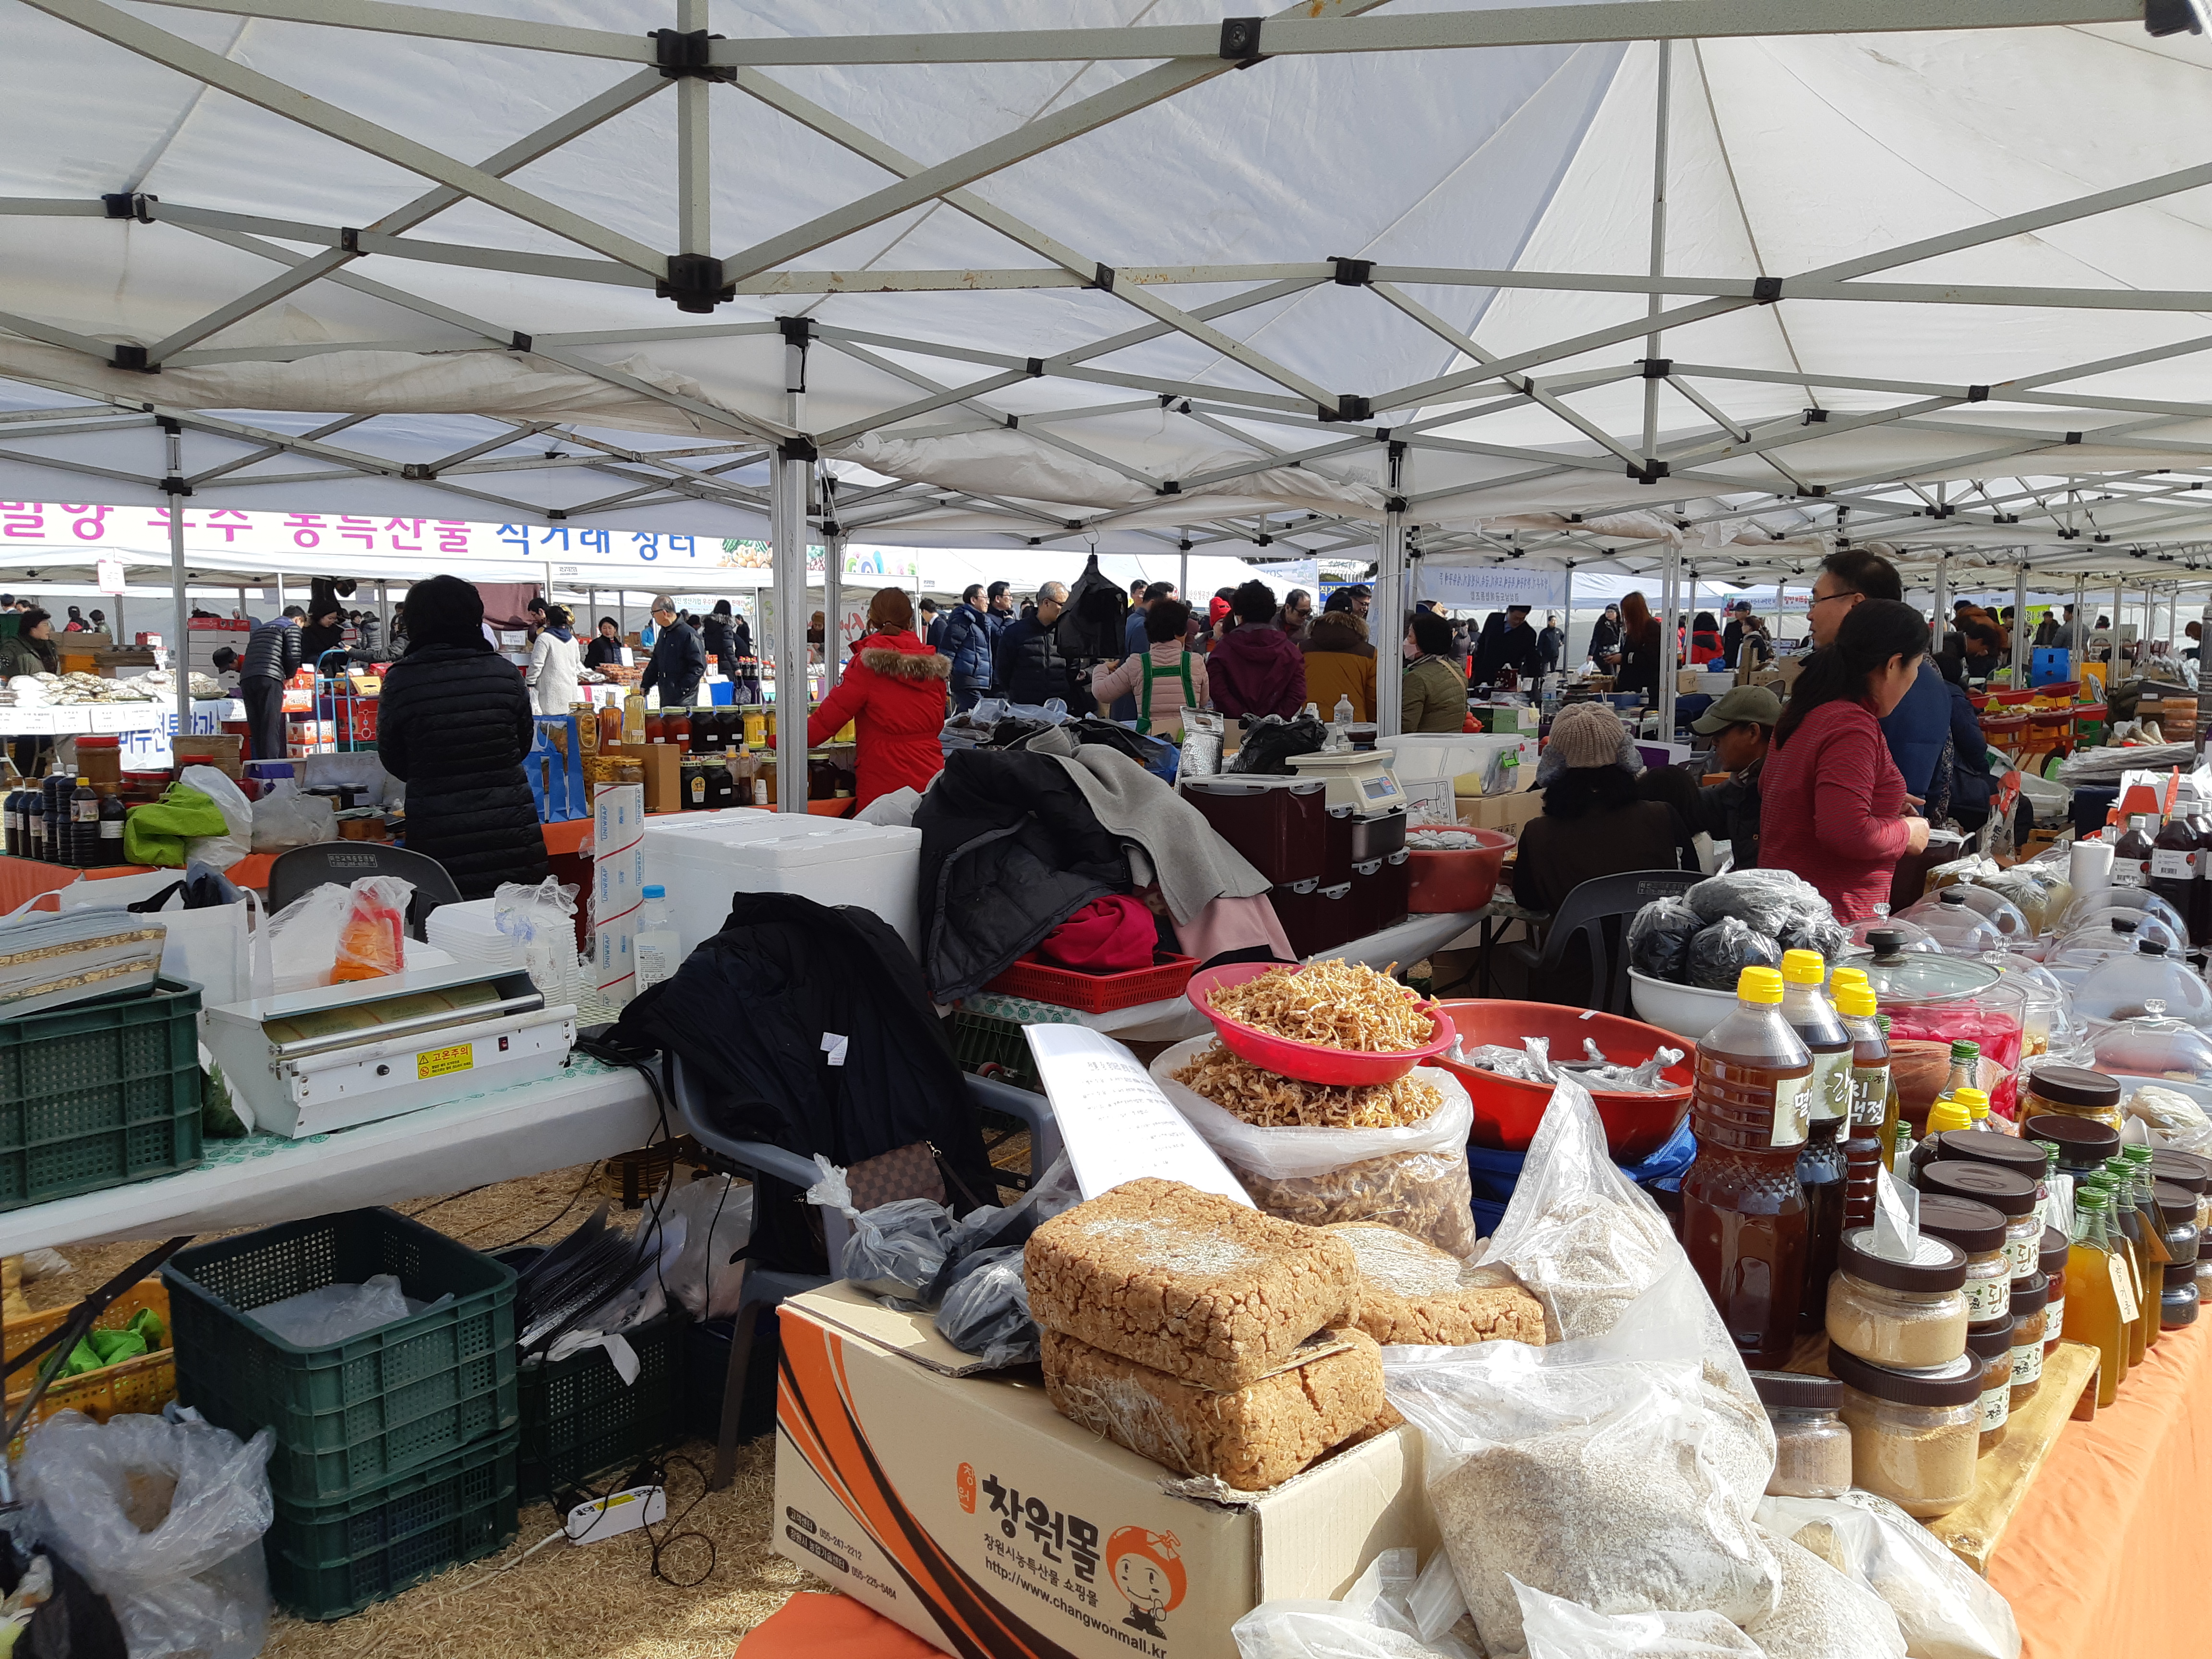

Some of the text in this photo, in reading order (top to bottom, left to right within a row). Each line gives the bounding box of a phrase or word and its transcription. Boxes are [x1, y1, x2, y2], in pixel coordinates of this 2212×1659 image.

[433, 1046, 469, 1062] 고온주의
[2017, 1243, 2037, 1273] 된장
[792, 1510, 813, 1532] 고객센터
[982, 1473, 1101, 1584] 창원몰
[790, 1528, 808, 1548] 창원시
[809, 1540, 845, 1571] 농업기술센터
[984, 1533, 1099, 1608] 창원시농특산물 쇼핑몰
[985, 1556, 1167, 1659] http://www.changwonmall.kr
